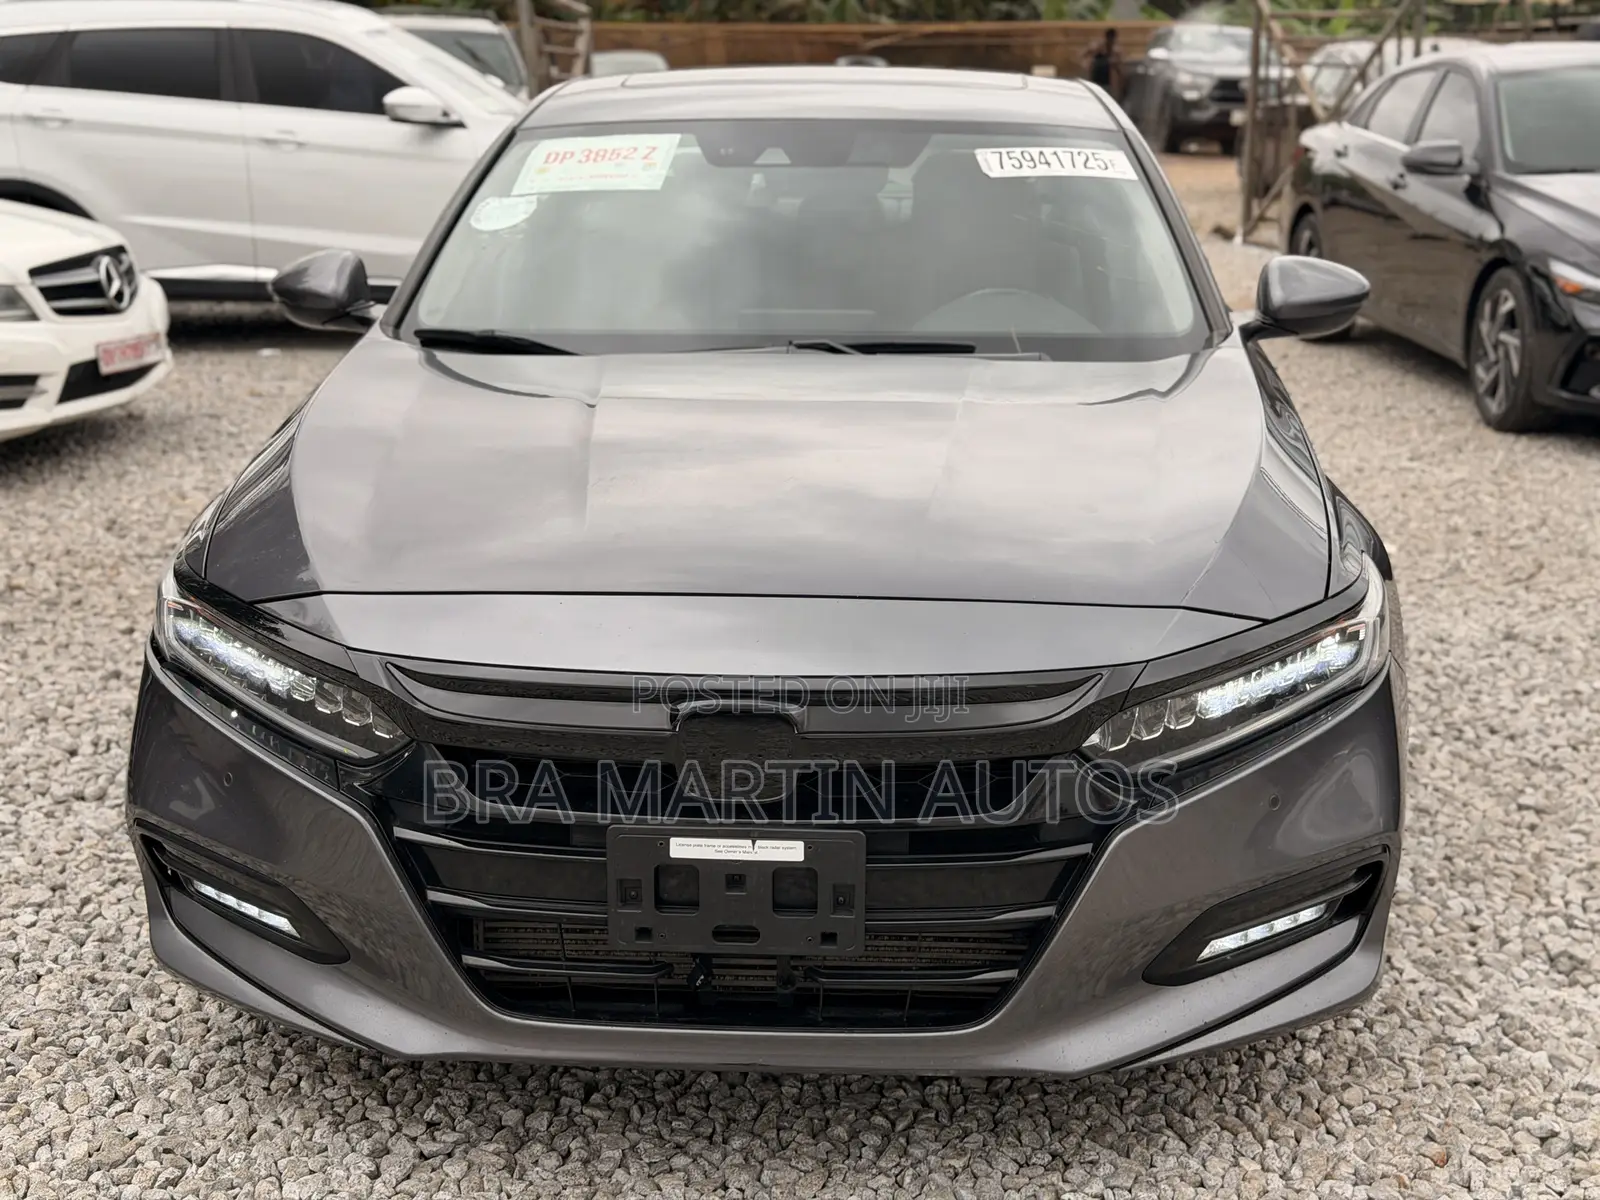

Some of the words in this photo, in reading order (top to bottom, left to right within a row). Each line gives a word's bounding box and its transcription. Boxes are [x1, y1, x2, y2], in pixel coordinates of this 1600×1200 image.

[543, 150, 576, 165] DP
[578, 146, 639, 164] 3852
[641, 145, 658, 161] Z
[990, 149, 1109, 171] 75941725
